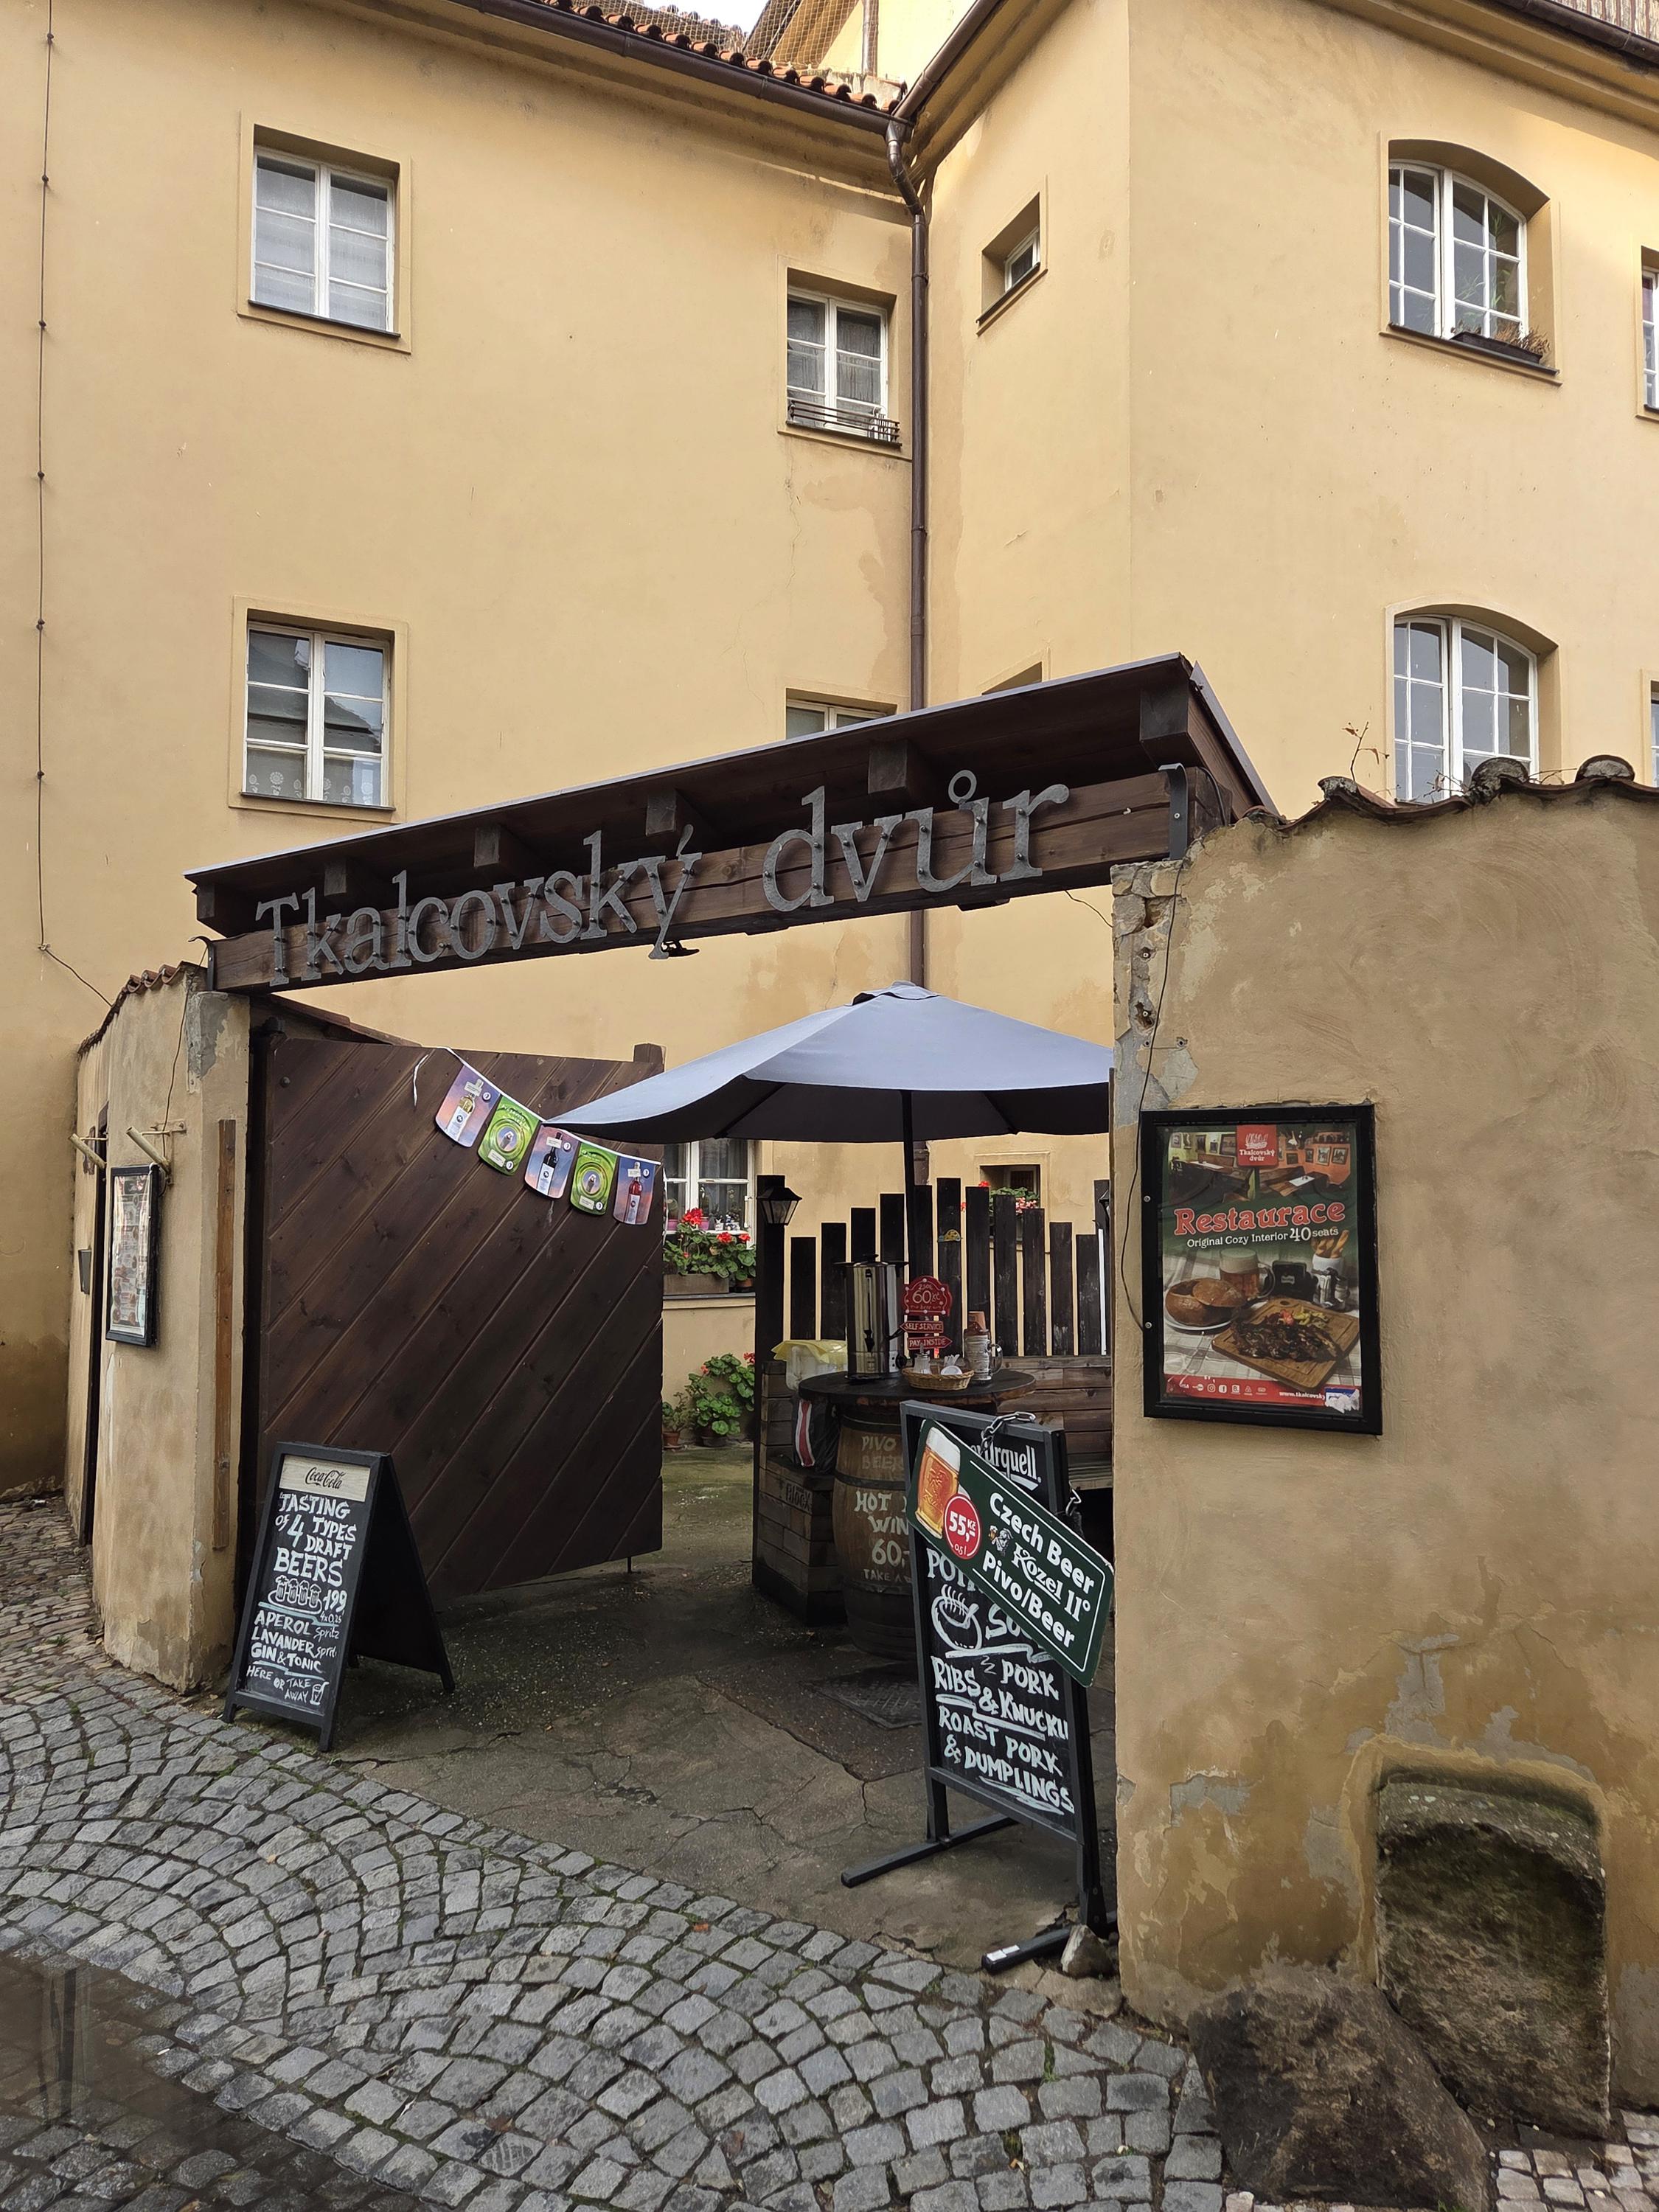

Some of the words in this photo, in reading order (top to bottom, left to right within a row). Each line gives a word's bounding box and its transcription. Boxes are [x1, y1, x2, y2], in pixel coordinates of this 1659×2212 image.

[255, 824, 702, 987] Tkalcovský
[762, 770, 1069, 912] dvůr
[1174, 1202, 1346, 1236] Restaurace
[1186, 1237, 1223, 1249] Original
[1225, 1235, 1249, 1245] Cozy
[1252, 1231, 1288, 1242] Interior
[1290, 1227, 1311, 1242] 40
[1312, 1227, 1339, 1237] seats
[909, 1340, 921, 1348] PAY
[923, 1338, 946, 1347] INSIDE
[861, 1436, 897, 1452] PIVO
[279, 1492, 351, 1520] TASTING
[854, 1489, 892, 1512] HOT
[287, 1514, 305, 1548] 4
[313, 1516, 357, 1543] TYPES
[304, 1534, 352, 1560] DRAFT
[990, 1492, 1043, 1553] Czech
[1046, 1539, 1094, 1595] Beer
[273, 1546, 343, 1587] BEERS
[863, 1568, 891, 1580] TAKE
[1011, 1543, 1063, 1600] Kozel
[982, 1550, 1075, 1648] Pivo/Beer
[254, 1610, 311, 1635] APEROL
[251, 1627, 317, 1659] LAVANDER
[251, 1642, 277, 1662] GIN
[277, 1651, 286, 1666] &
[286, 1653, 323, 1674] TONIC
[246, 1665, 274, 1680] HERE
[273, 1677, 285, 1691] OR
[286, 1678, 311, 1689] TAKE
[931, 1655, 981, 1697] RIBS
[978, 1686, 999, 1716] &
[1000, 1658, 1059, 1700] PORK
[285, 1689, 310, 1703] AWAY
[939, 1705, 999, 1747] ROAST
[1005, 1735, 1063, 1777] PORK
[944, 1733, 961, 1764] &
[964, 1745, 1075, 1815] DUMPLINGS
